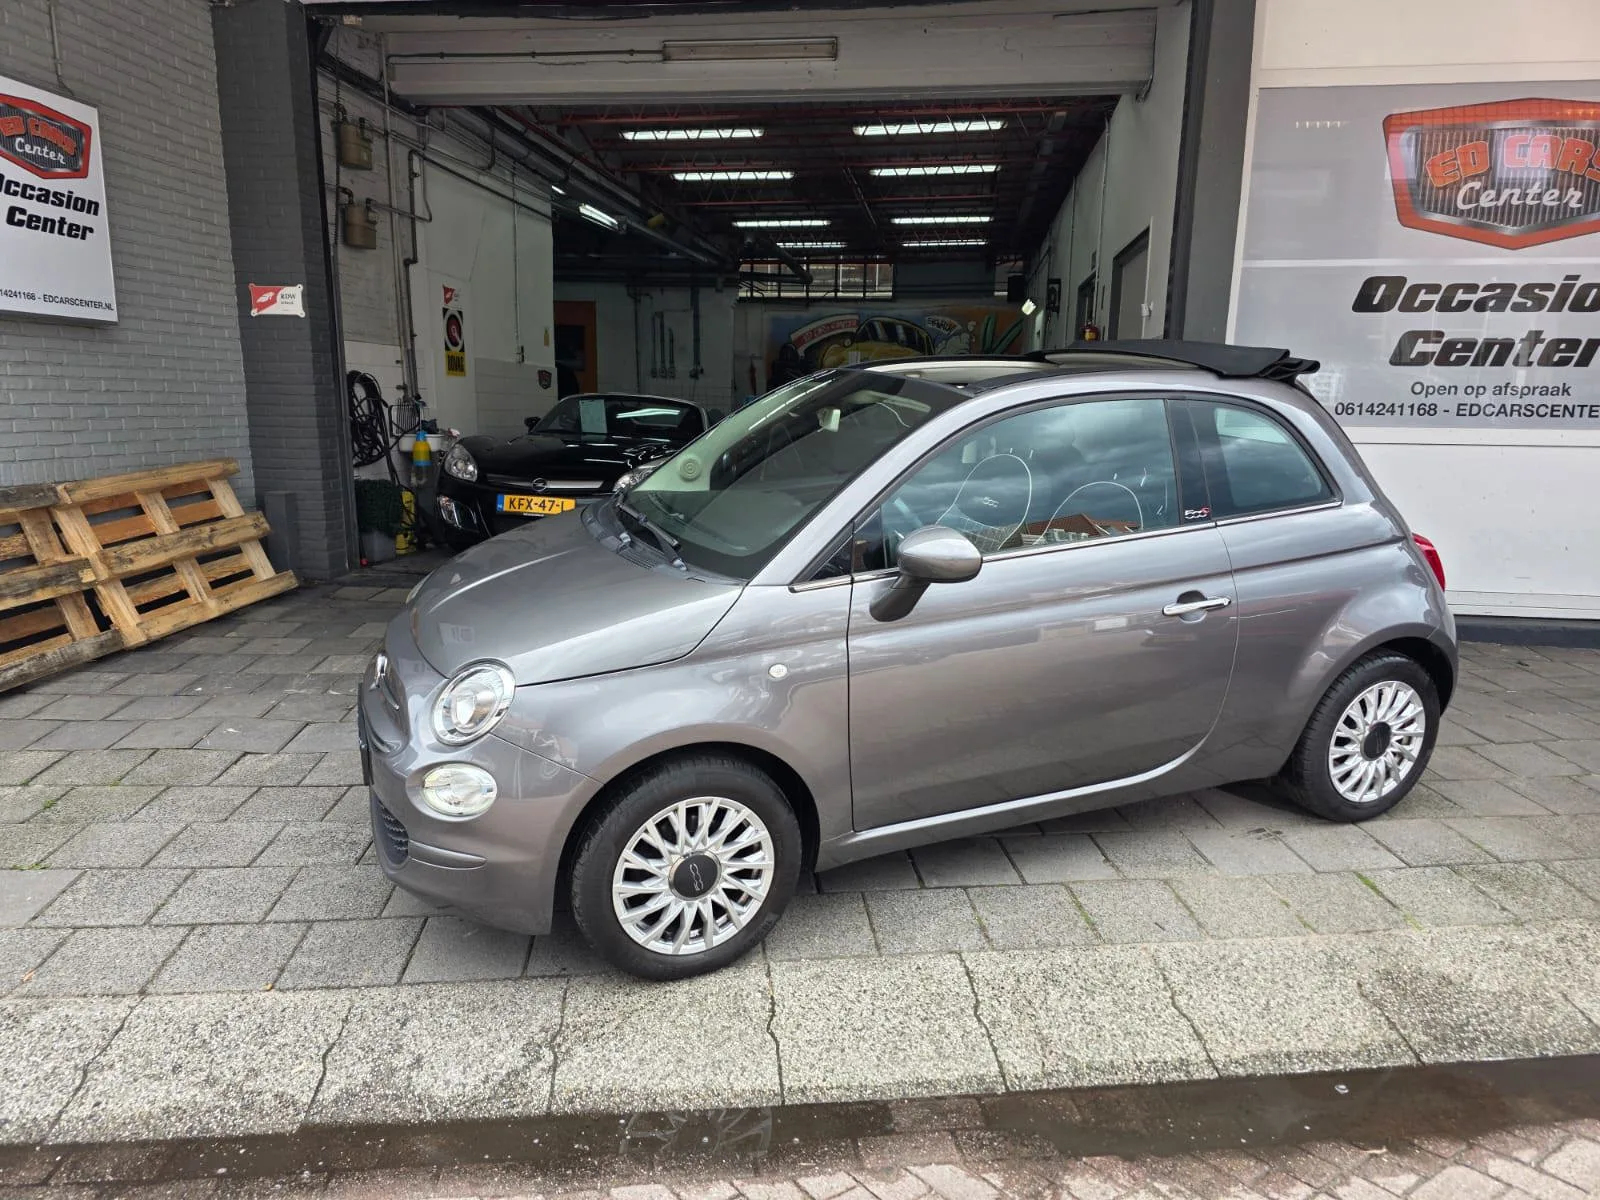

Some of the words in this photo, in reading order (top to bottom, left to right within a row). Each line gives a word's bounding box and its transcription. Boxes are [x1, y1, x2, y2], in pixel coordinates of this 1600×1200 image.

[15, 137, 66, 164] Center
[1425, 141, 1490, 188] ED
[1456, 181, 1583, 210] Center
[6, 205, 94, 241] Center
[43, 294, 114, 311] EDCARSCENTER.NL
[1410, 381, 1458, 399] Open
[1463, 386, 1487, 399] op
[1492, 381, 1572, 399] afspraak
[1334, 402, 1438, 417] 0614241168
